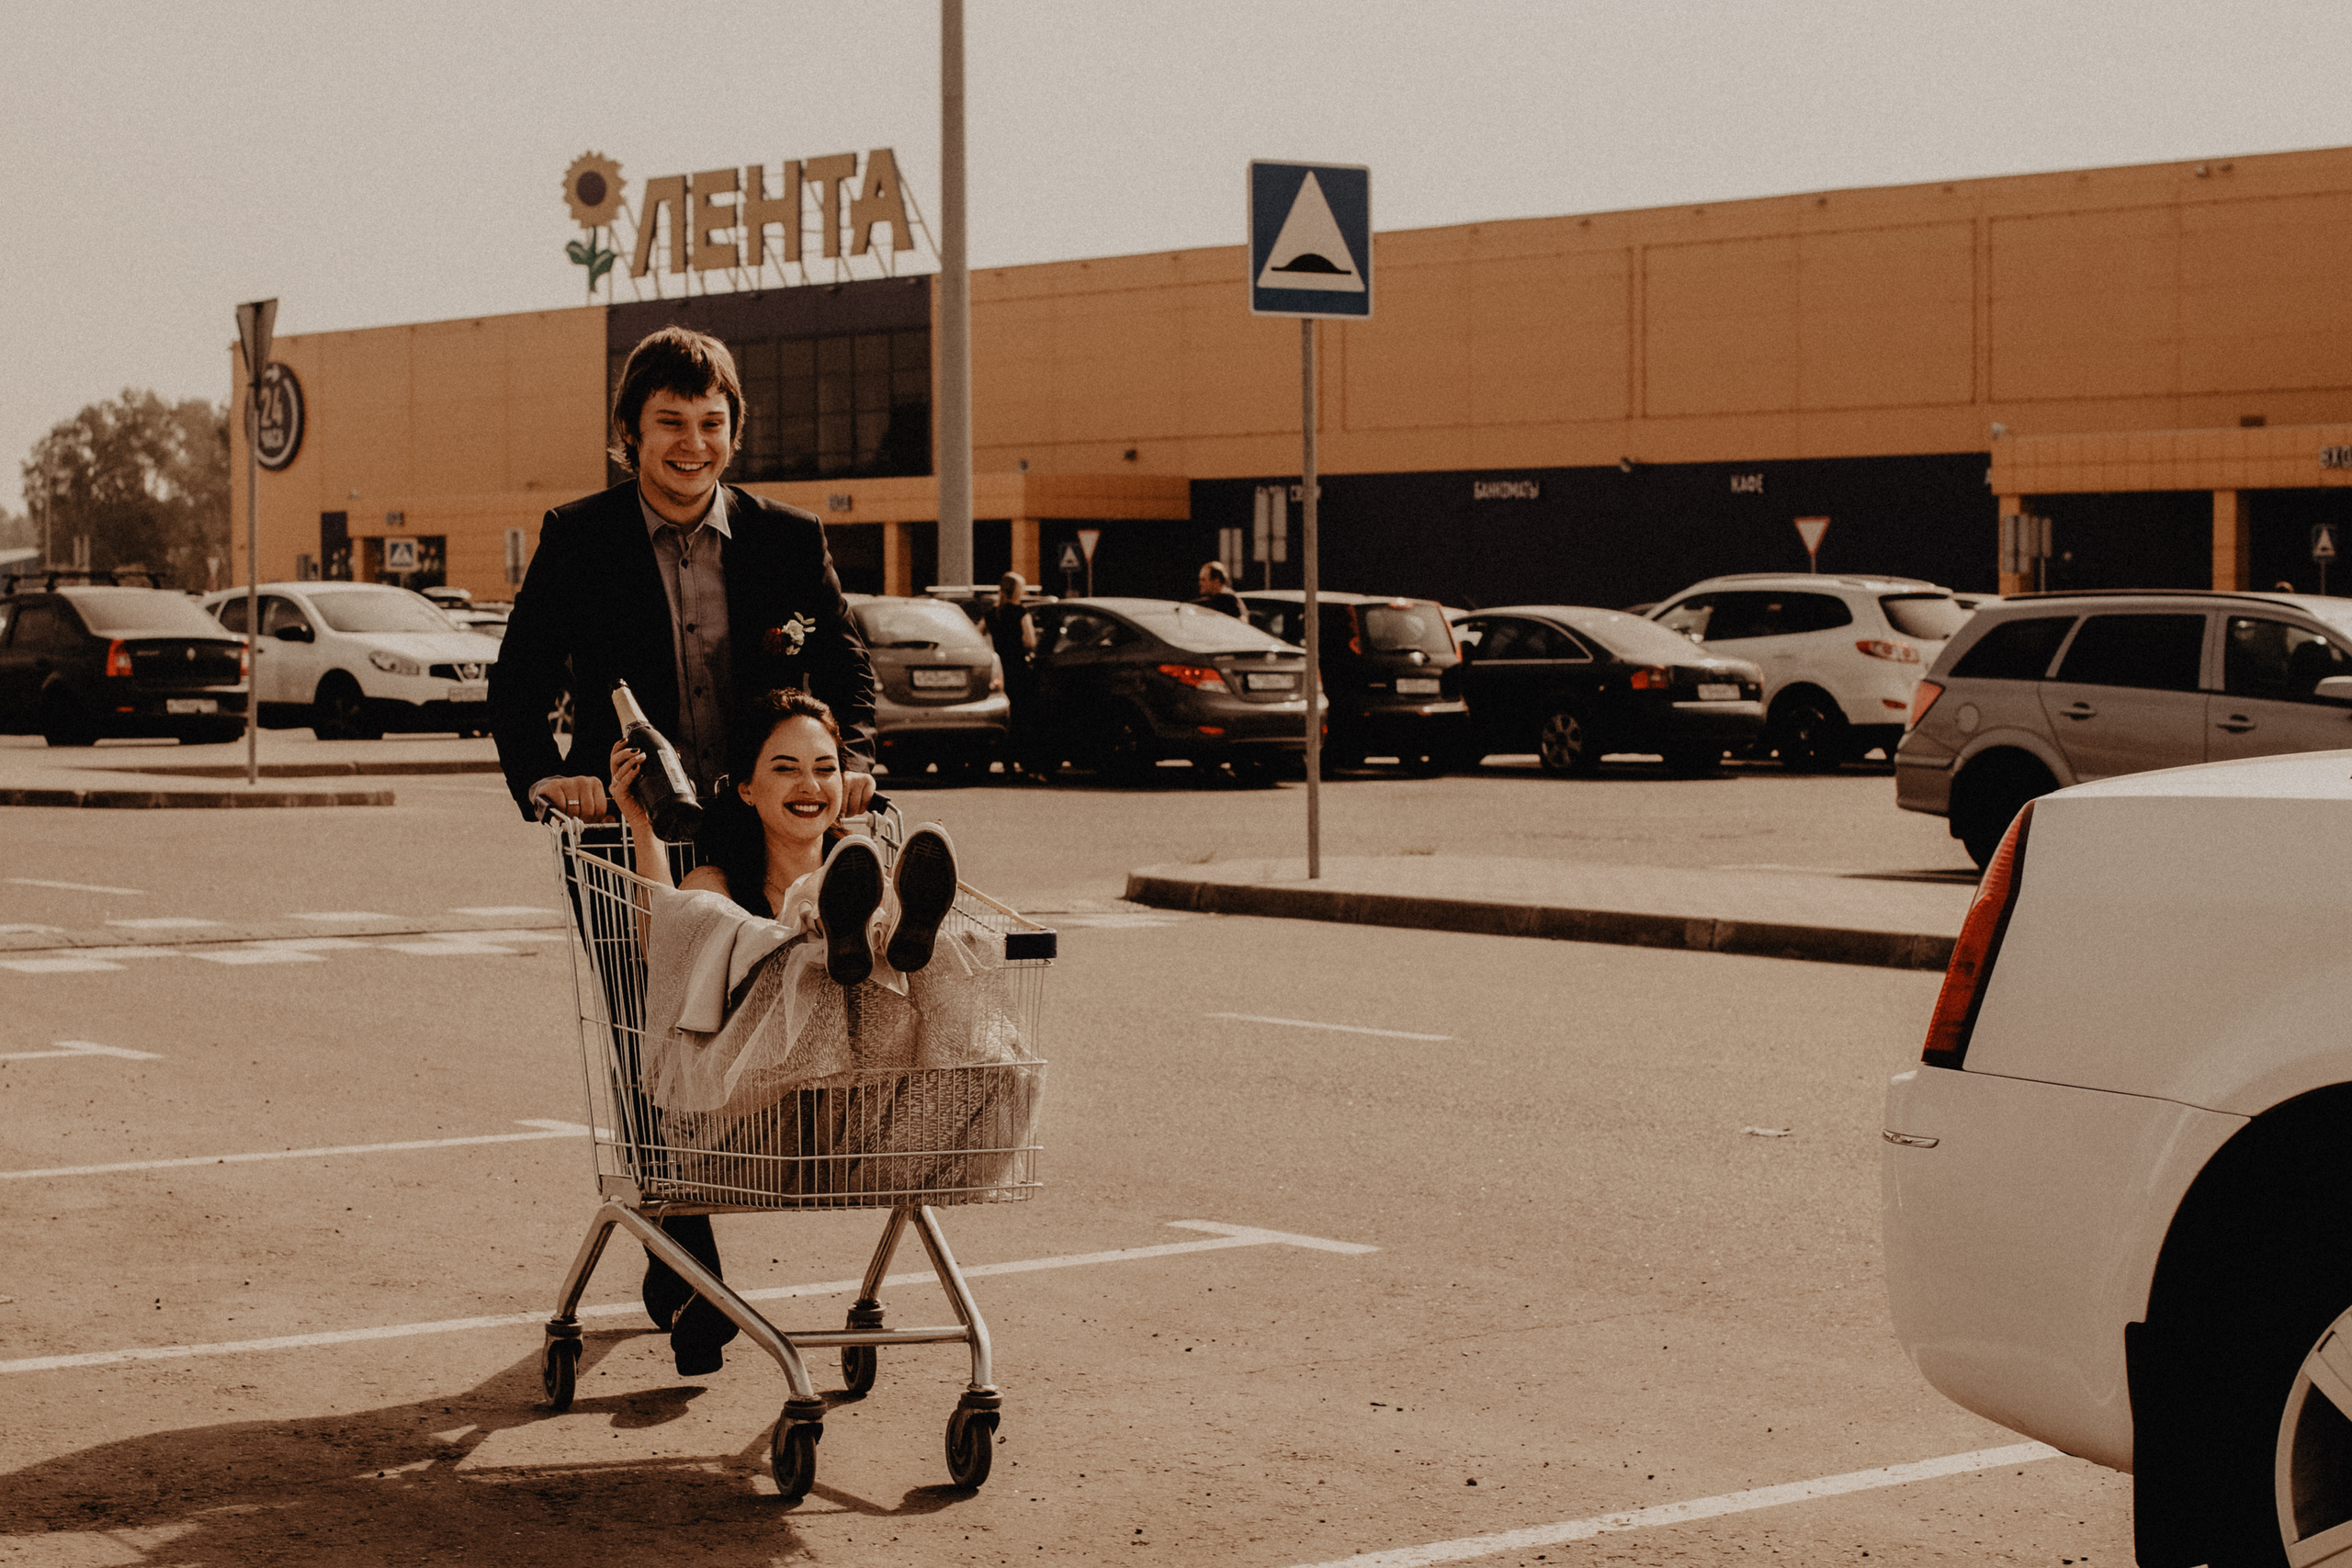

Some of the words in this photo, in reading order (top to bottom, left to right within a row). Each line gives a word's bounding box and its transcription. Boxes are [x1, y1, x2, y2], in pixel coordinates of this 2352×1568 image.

[631, 147, 914, 278] ЛЕНТА
[260, 386, 283, 428] 24
[1474, 480, 1540, 501] БАНКОМАТЫ
[1730, 474, 1764, 494] КАФЕ
